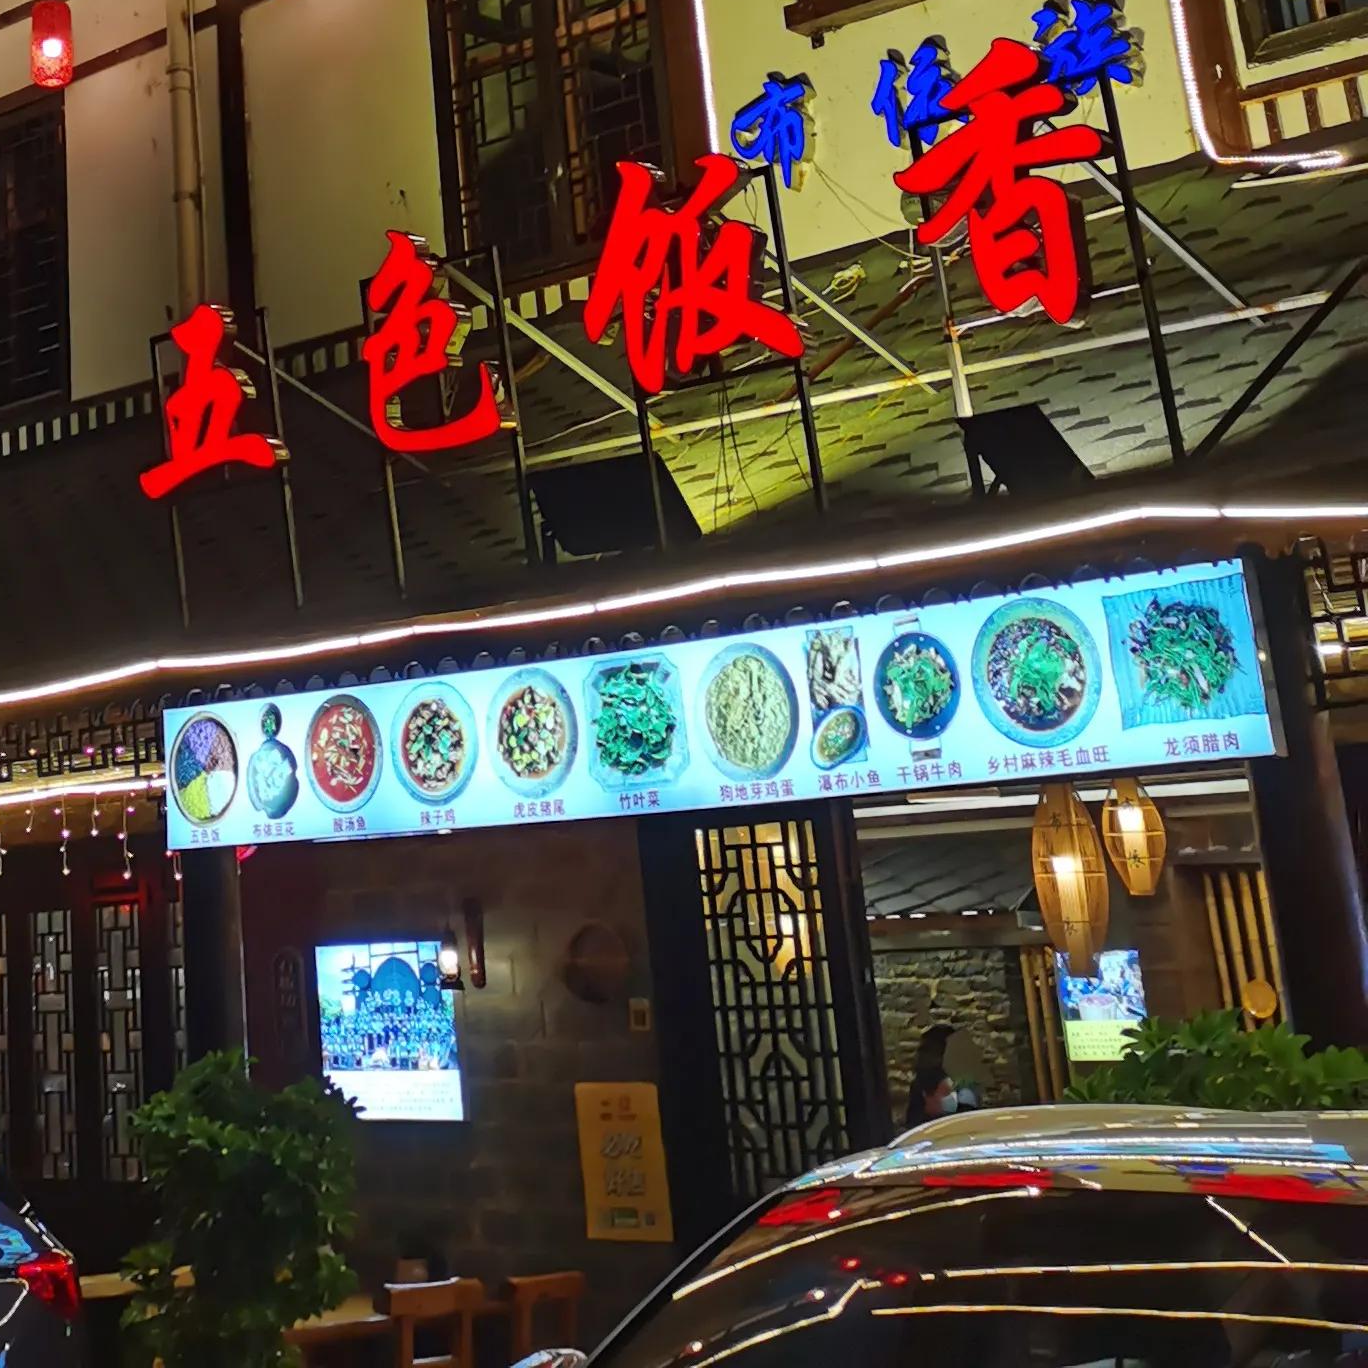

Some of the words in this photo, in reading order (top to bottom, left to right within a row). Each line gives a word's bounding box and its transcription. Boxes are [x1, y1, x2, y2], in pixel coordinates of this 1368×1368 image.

[732, 0, 1131, 188] 布依族
[140, 36, 1105, 500] 五色饭香
[1163, 731, 1240, 757] 龙须腊肉
[987, 745, 1110, 775] 乡村麻辣毛血旺
[818, 770, 882, 792] 瀑布小鱼
[897, 760, 962, 783] 干锅牛肉
[513, 798, 566, 819] 虎皮猪尾
[619, 790, 661, 809] 竹叶菜
[333, 816, 367, 832] 酸汤鱼
[420, 808, 456, 826] 辣子鸡
